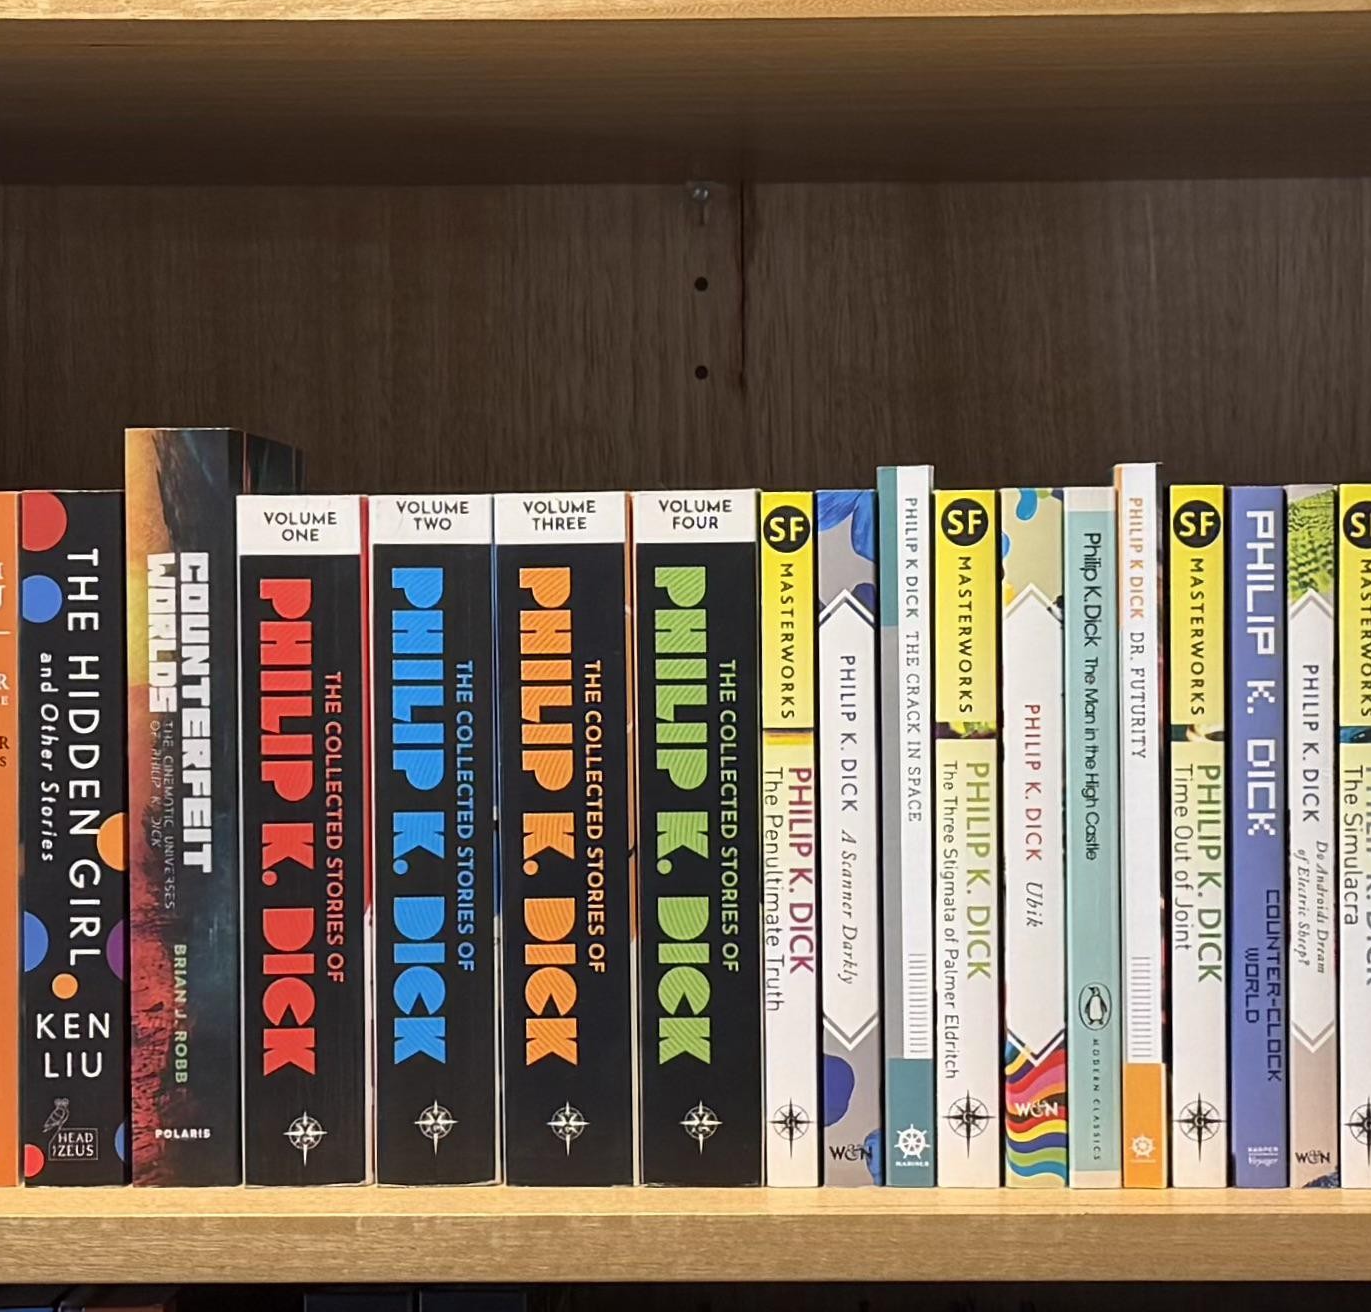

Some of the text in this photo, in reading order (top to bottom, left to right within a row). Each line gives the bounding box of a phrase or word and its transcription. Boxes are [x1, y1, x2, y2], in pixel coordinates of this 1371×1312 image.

[264, 512, 337, 526] VOLUME
[282, 529, 319, 542] ONE
[780, 563, 795, 720] MASTERWORKS
[1246, 510, 1277, 837] PHILIP K. DICK
[65, 548, 102, 967] THE HIDDEN GIRL
[260, 578, 316, 1076] PHILIP K. DICK
[585, 661, 605, 973] THE COLLECTED STORIES OF
[764, 767, 783, 1012] The Penultimate Truth
[1245, 947, 1259, 1025] WORLD
[1265, 889, 1282, 1083] COUNTER-CLOCK
